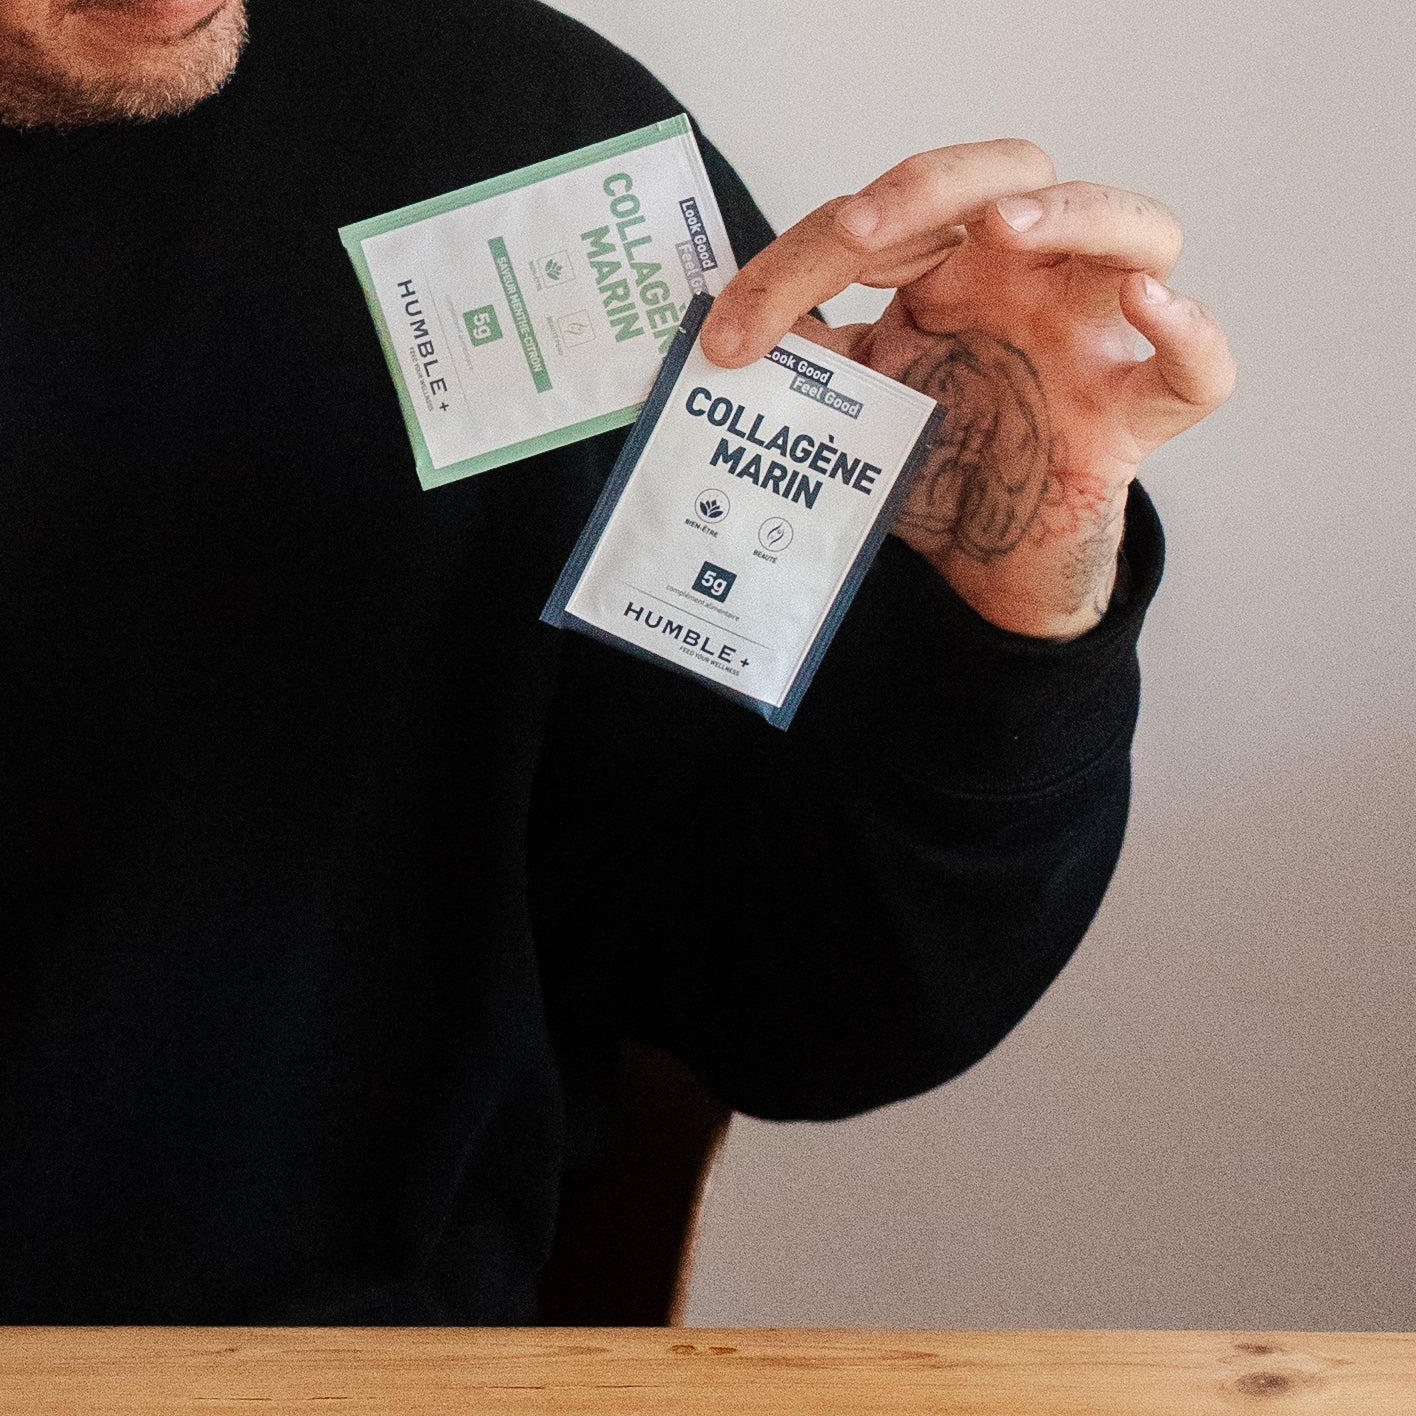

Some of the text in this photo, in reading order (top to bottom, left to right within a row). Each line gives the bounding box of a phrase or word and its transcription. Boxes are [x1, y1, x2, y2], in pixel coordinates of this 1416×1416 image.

[678, 244, 700, 276] Feel
[682, 200, 715, 269] Look Good
[580, 225, 645, 342] MARIN
[603, 172, 688, 354] COLLAGÈN
[473, 312, 492, 340] 5g
[496, 256, 543, 372] SAVEUR MENTHE-CITRON
[793, 376, 859, 417] Feel Good
[797, 360, 830, 383] Good
[685, 386, 882, 495] COLLAGÈNE
[709, 437, 823, 510] MARIN
[685, 518, 719, 538] BIEN-ÊTRE
[701, 570, 728, 596] 5g
